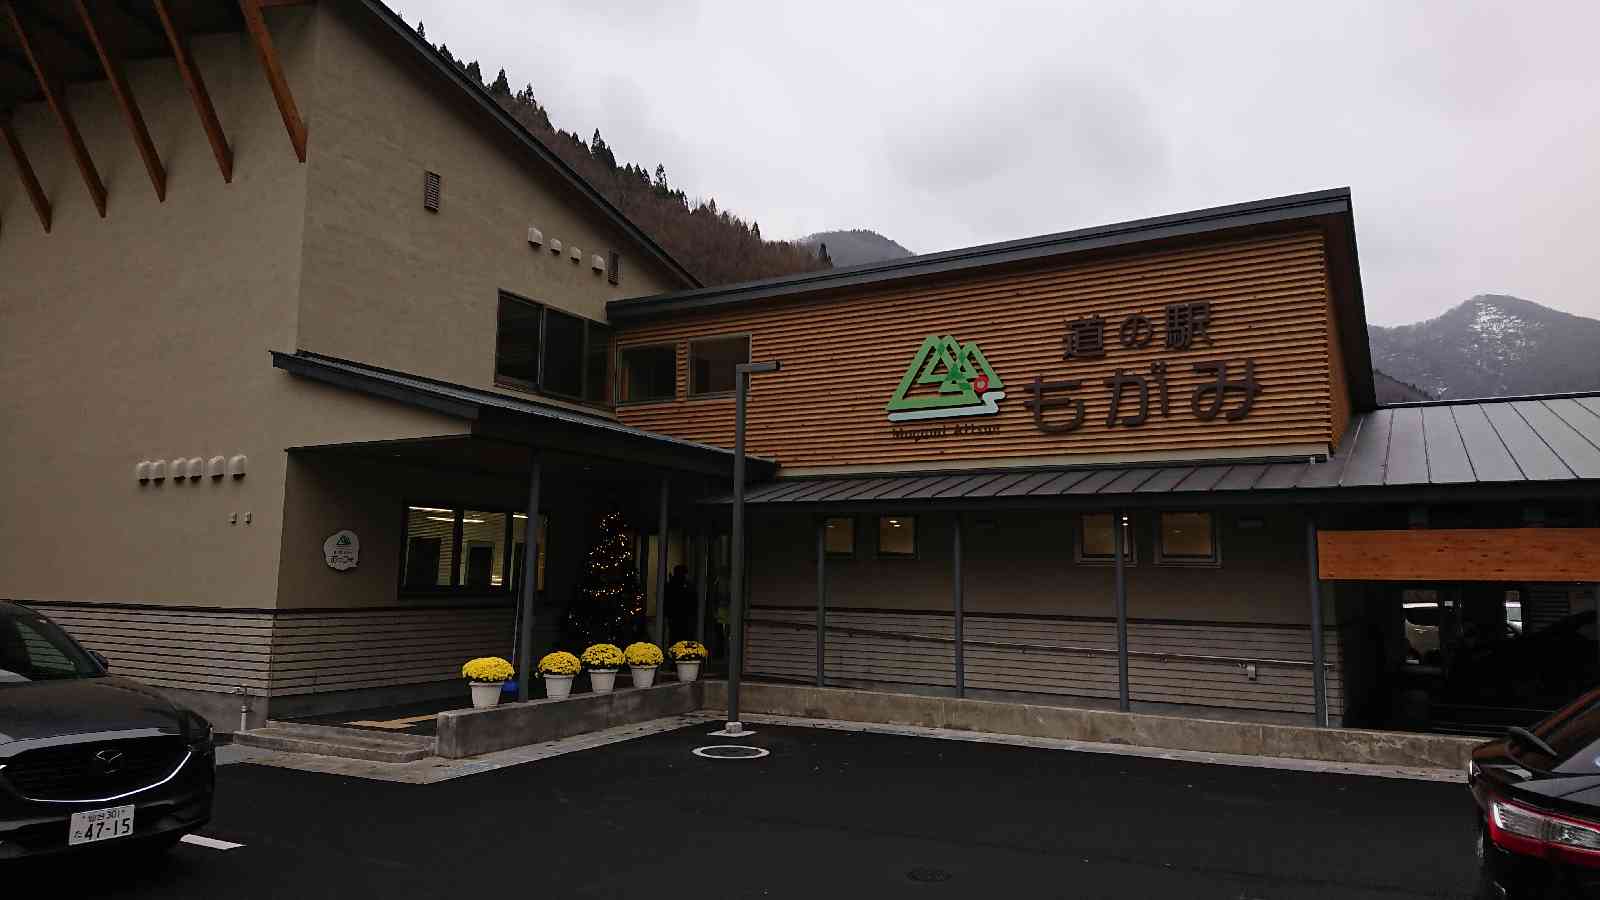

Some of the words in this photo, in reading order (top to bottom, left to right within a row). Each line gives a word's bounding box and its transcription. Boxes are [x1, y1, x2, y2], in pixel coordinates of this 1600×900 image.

[1062, 301, 1214, 360] 道の駅
[1023, 356, 1263, 436] もがみ
[84, 818, 131, 841] 47-15
